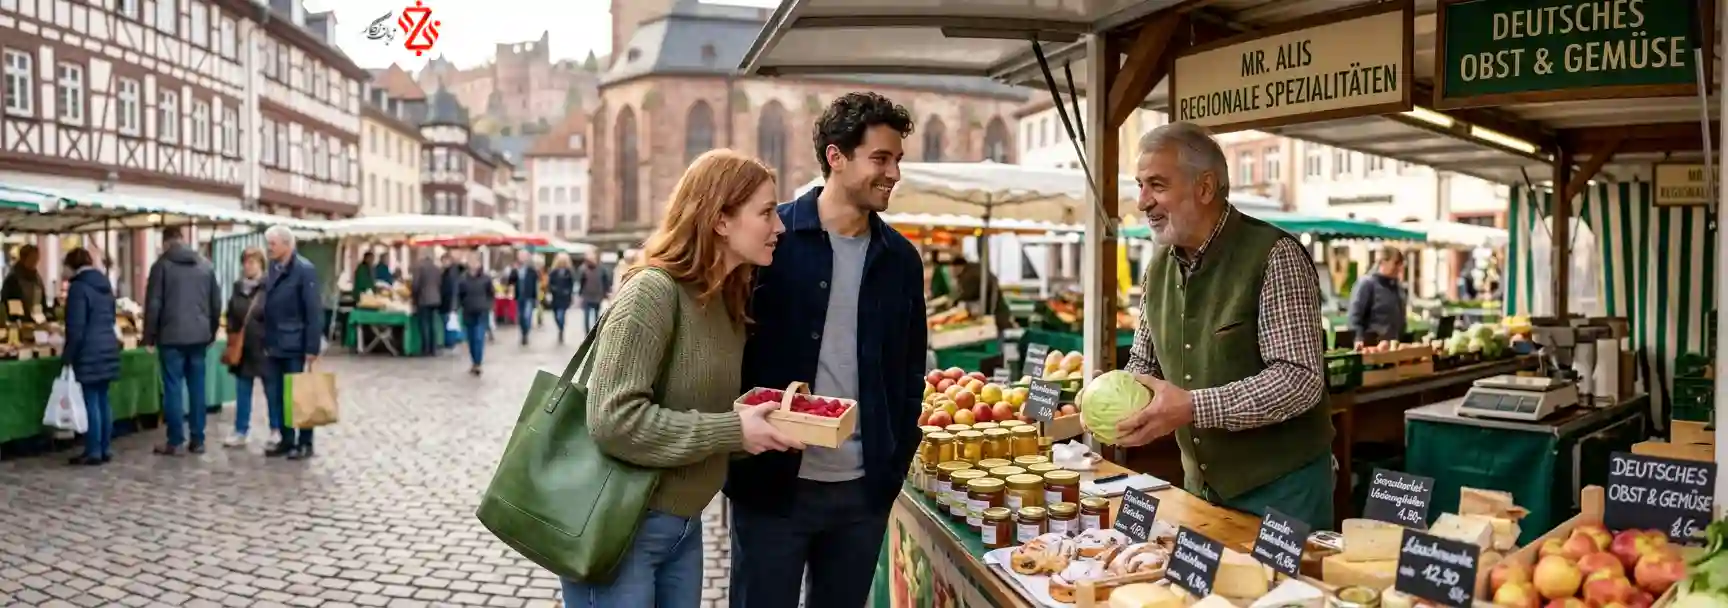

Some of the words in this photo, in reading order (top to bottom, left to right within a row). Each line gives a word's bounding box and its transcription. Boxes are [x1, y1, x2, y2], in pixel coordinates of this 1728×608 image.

[1493, 0, 1645, 41] DEUTSCHES
[1241, 50, 1270, 78] MR.
[1275, 39, 1312, 72] ALIS
[1460, 48, 1526, 82] OBST
[1533, 47, 1555, 75] &
[1564, 31, 1687, 73] GEMÜSE
[1180, 84, 1260, 121] REGIONALE
[1265, 62, 1398, 109] SPEZIALITÄTEN
[1611, 457, 1709, 486] DEUTSCHES
[1608, 484, 1647, 504] OBST
[1646, 488, 1658, 506] &
[1659, 489, 1713, 513] GEMÜSE
